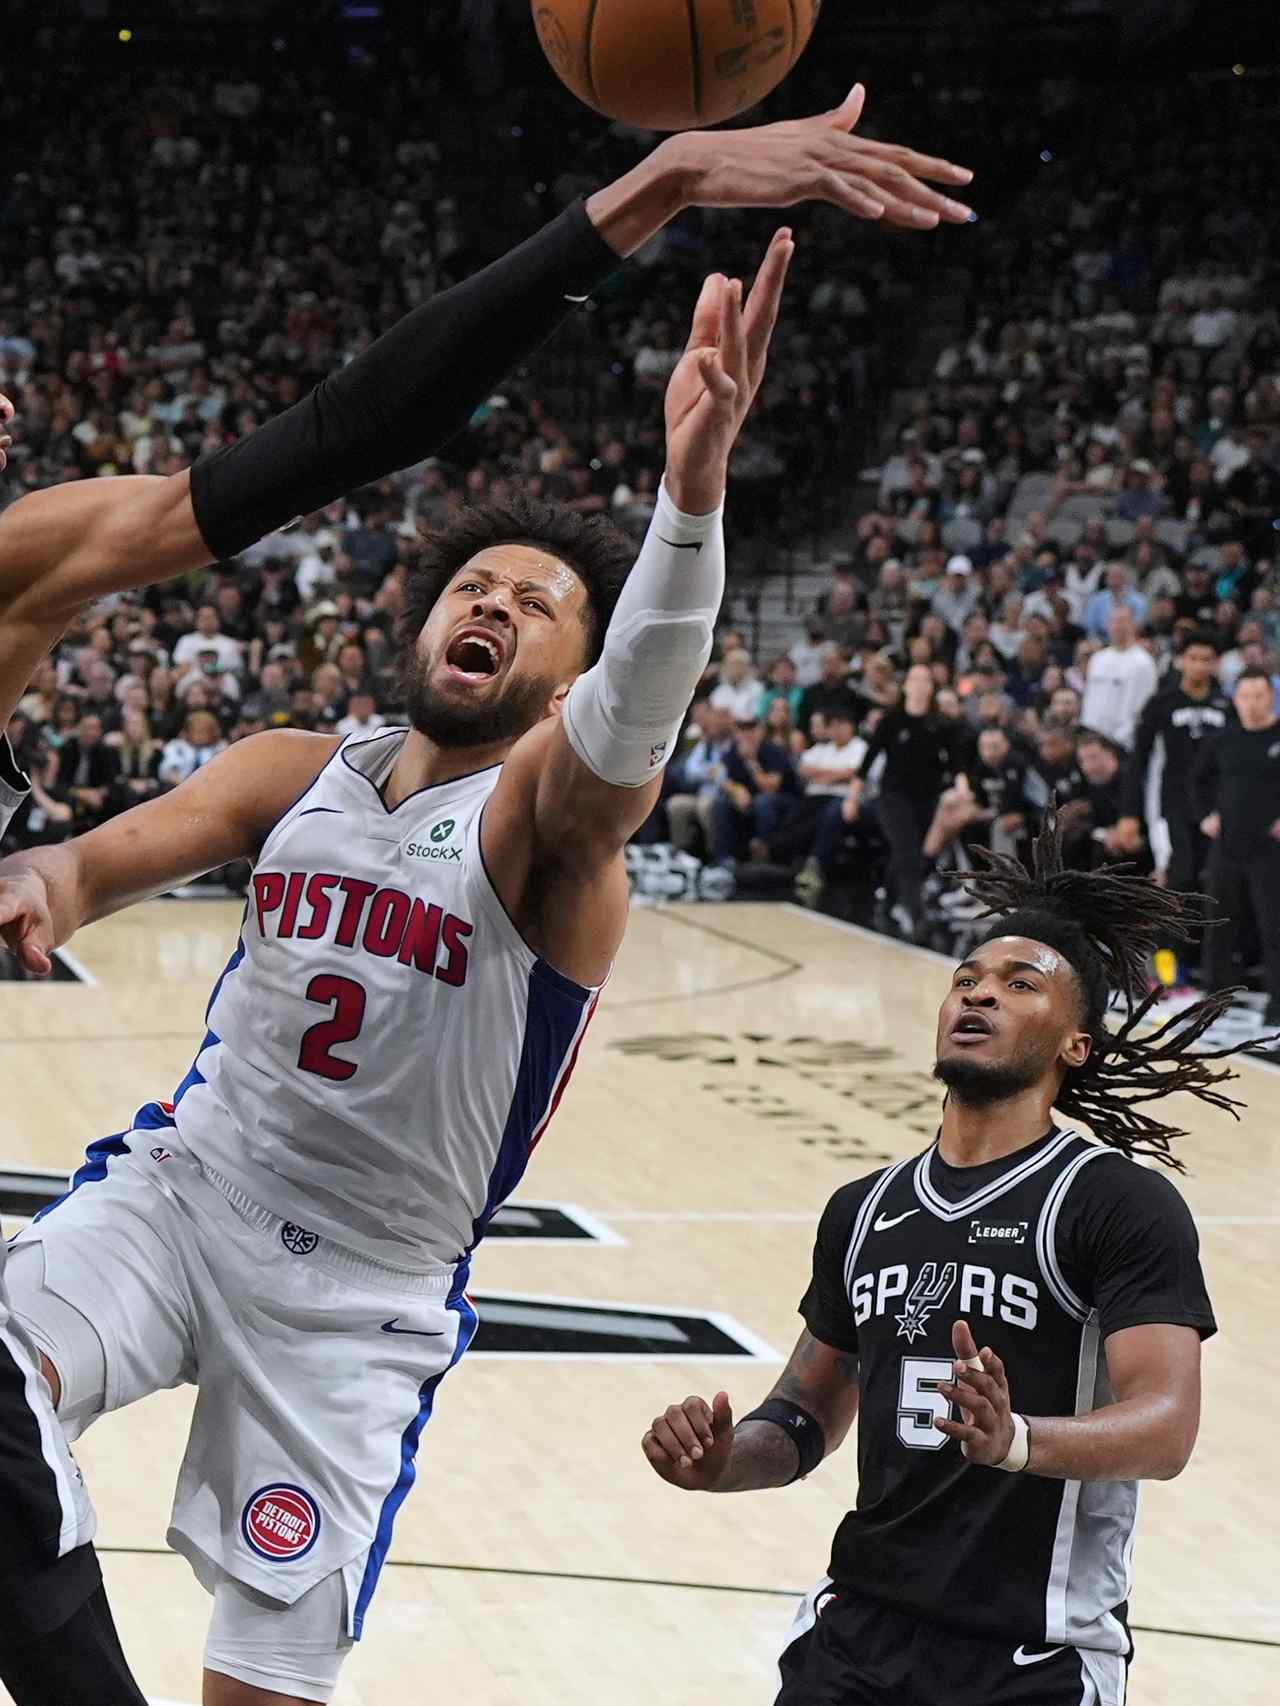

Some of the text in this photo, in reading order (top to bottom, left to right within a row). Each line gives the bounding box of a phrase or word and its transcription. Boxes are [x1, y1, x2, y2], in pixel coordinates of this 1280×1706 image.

[406, 842, 463, 861] StockX
[252, 871, 474, 988] PISTONS
[296, 973, 367, 1082] 2
[975, 1226, 1020, 1238] LEDGER
[852, 1262, 1039, 1337] SPURS
[896, 1355, 958, 1451] 5
[255, 1511, 301, 1545] PISTONS
[262, 1500, 308, 1533] DETROIT
